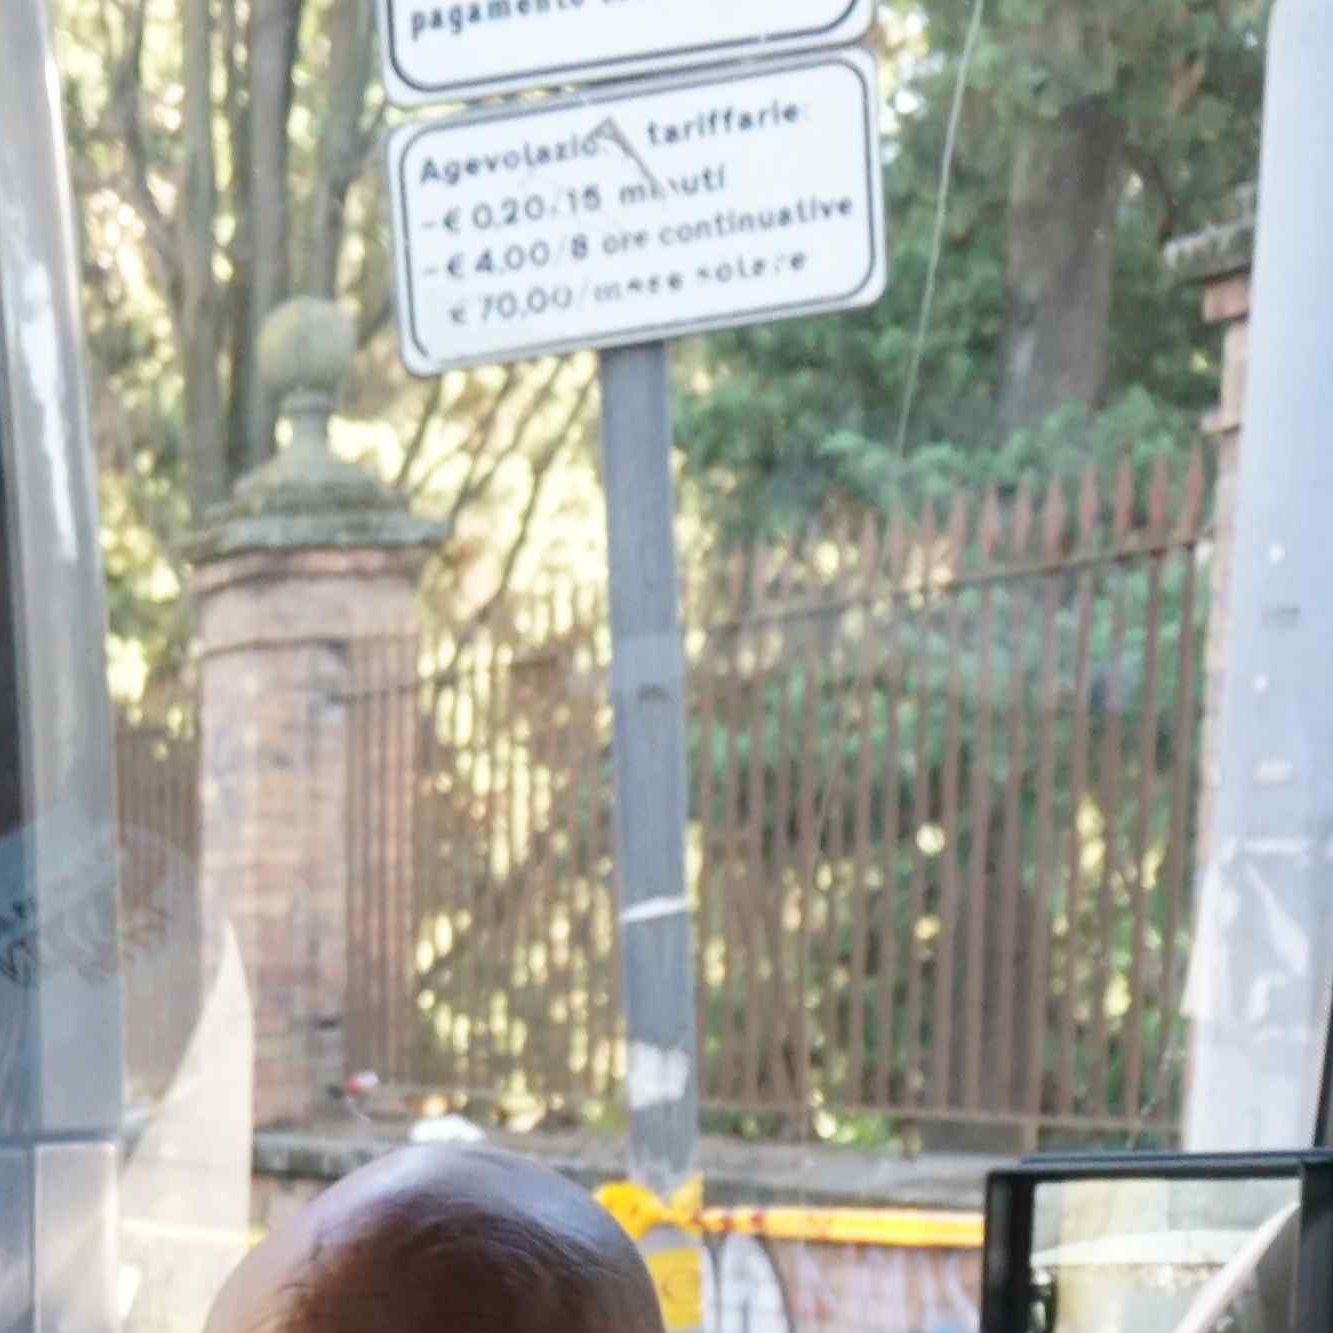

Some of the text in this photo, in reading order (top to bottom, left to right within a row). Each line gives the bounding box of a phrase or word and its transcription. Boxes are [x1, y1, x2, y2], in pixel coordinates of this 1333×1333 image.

[411, 0, 584, 42] pagamen
[420, 133, 600, 186] Agevolazio
[657, 197, 853, 246] continuative
